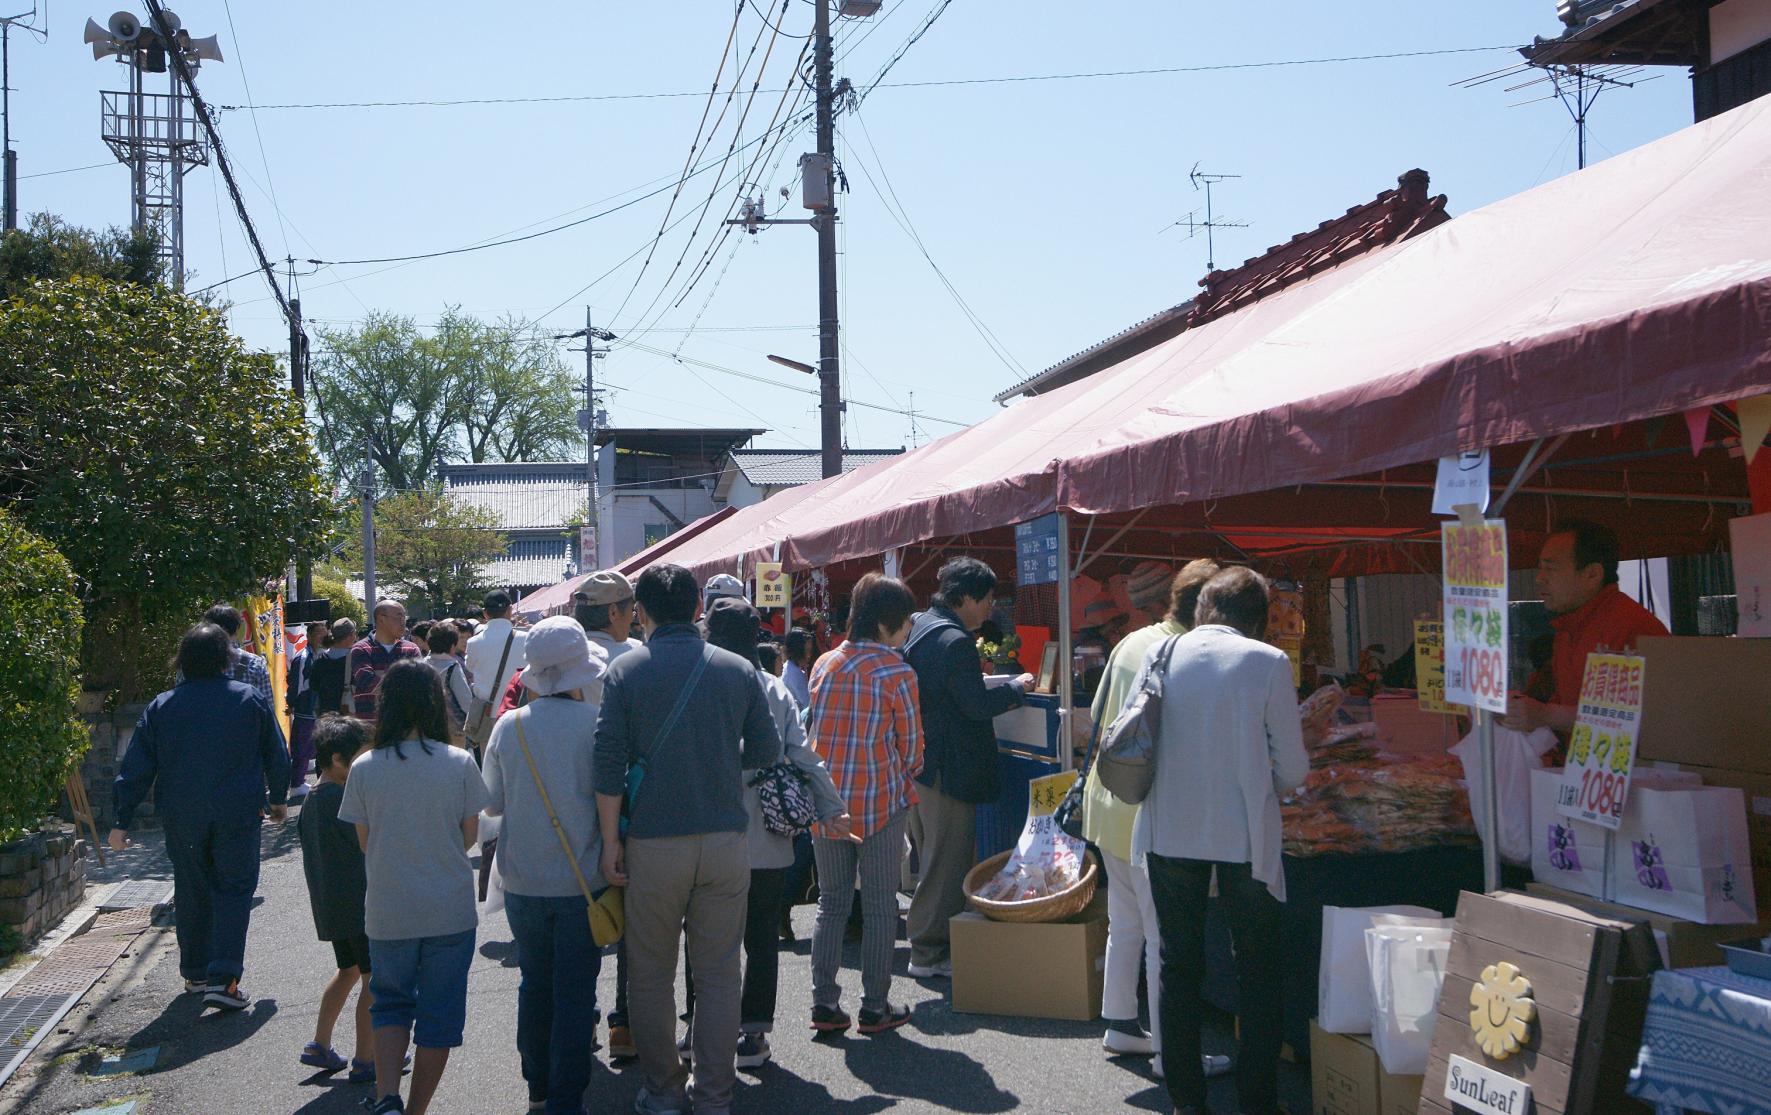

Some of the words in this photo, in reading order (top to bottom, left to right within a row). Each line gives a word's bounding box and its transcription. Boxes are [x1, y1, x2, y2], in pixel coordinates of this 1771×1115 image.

[764, 584, 782, 592] 赤飯
[764, 594, 781, 602] 300円
[1449, 1065, 1518, 1115] SunLeaf
